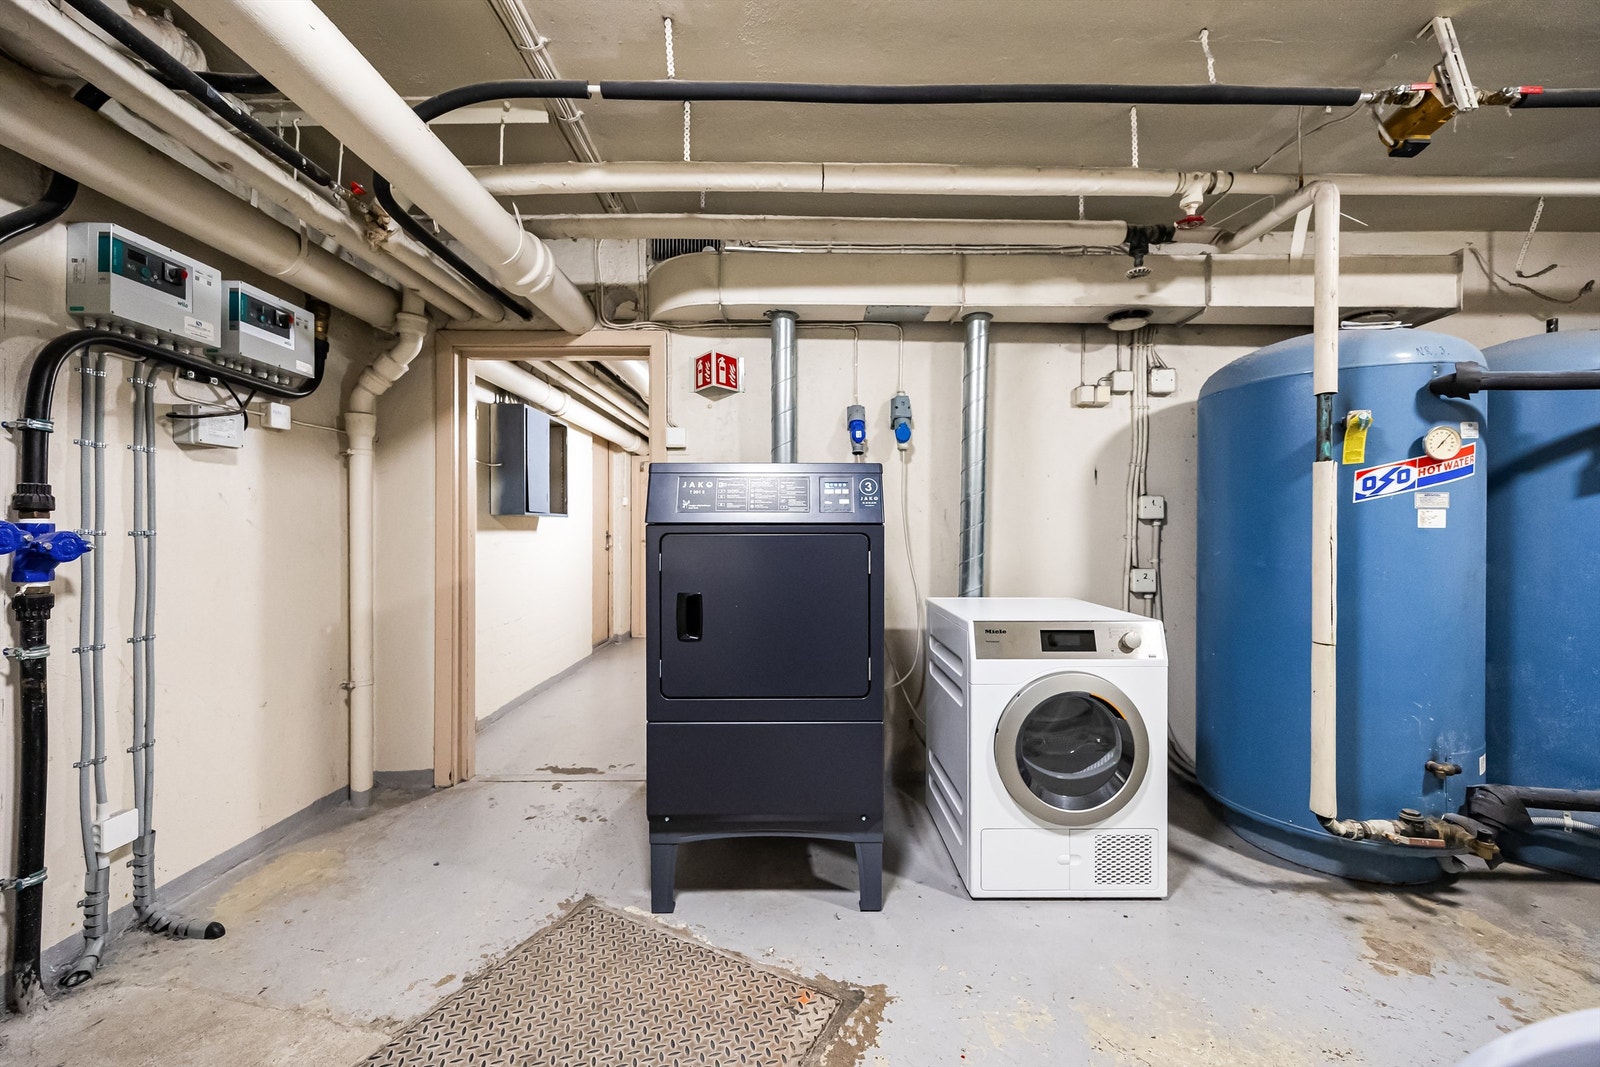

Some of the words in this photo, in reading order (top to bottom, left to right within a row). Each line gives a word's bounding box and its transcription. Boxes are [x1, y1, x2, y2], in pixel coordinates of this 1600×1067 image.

[1362, 466, 1411, 496] OSO
[1418, 464, 1443, 477] HOT
[1443, 455, 1475, 471] WATER
[682, 481, 714, 489] JAKO
[864, 481, 873, 492] 3
